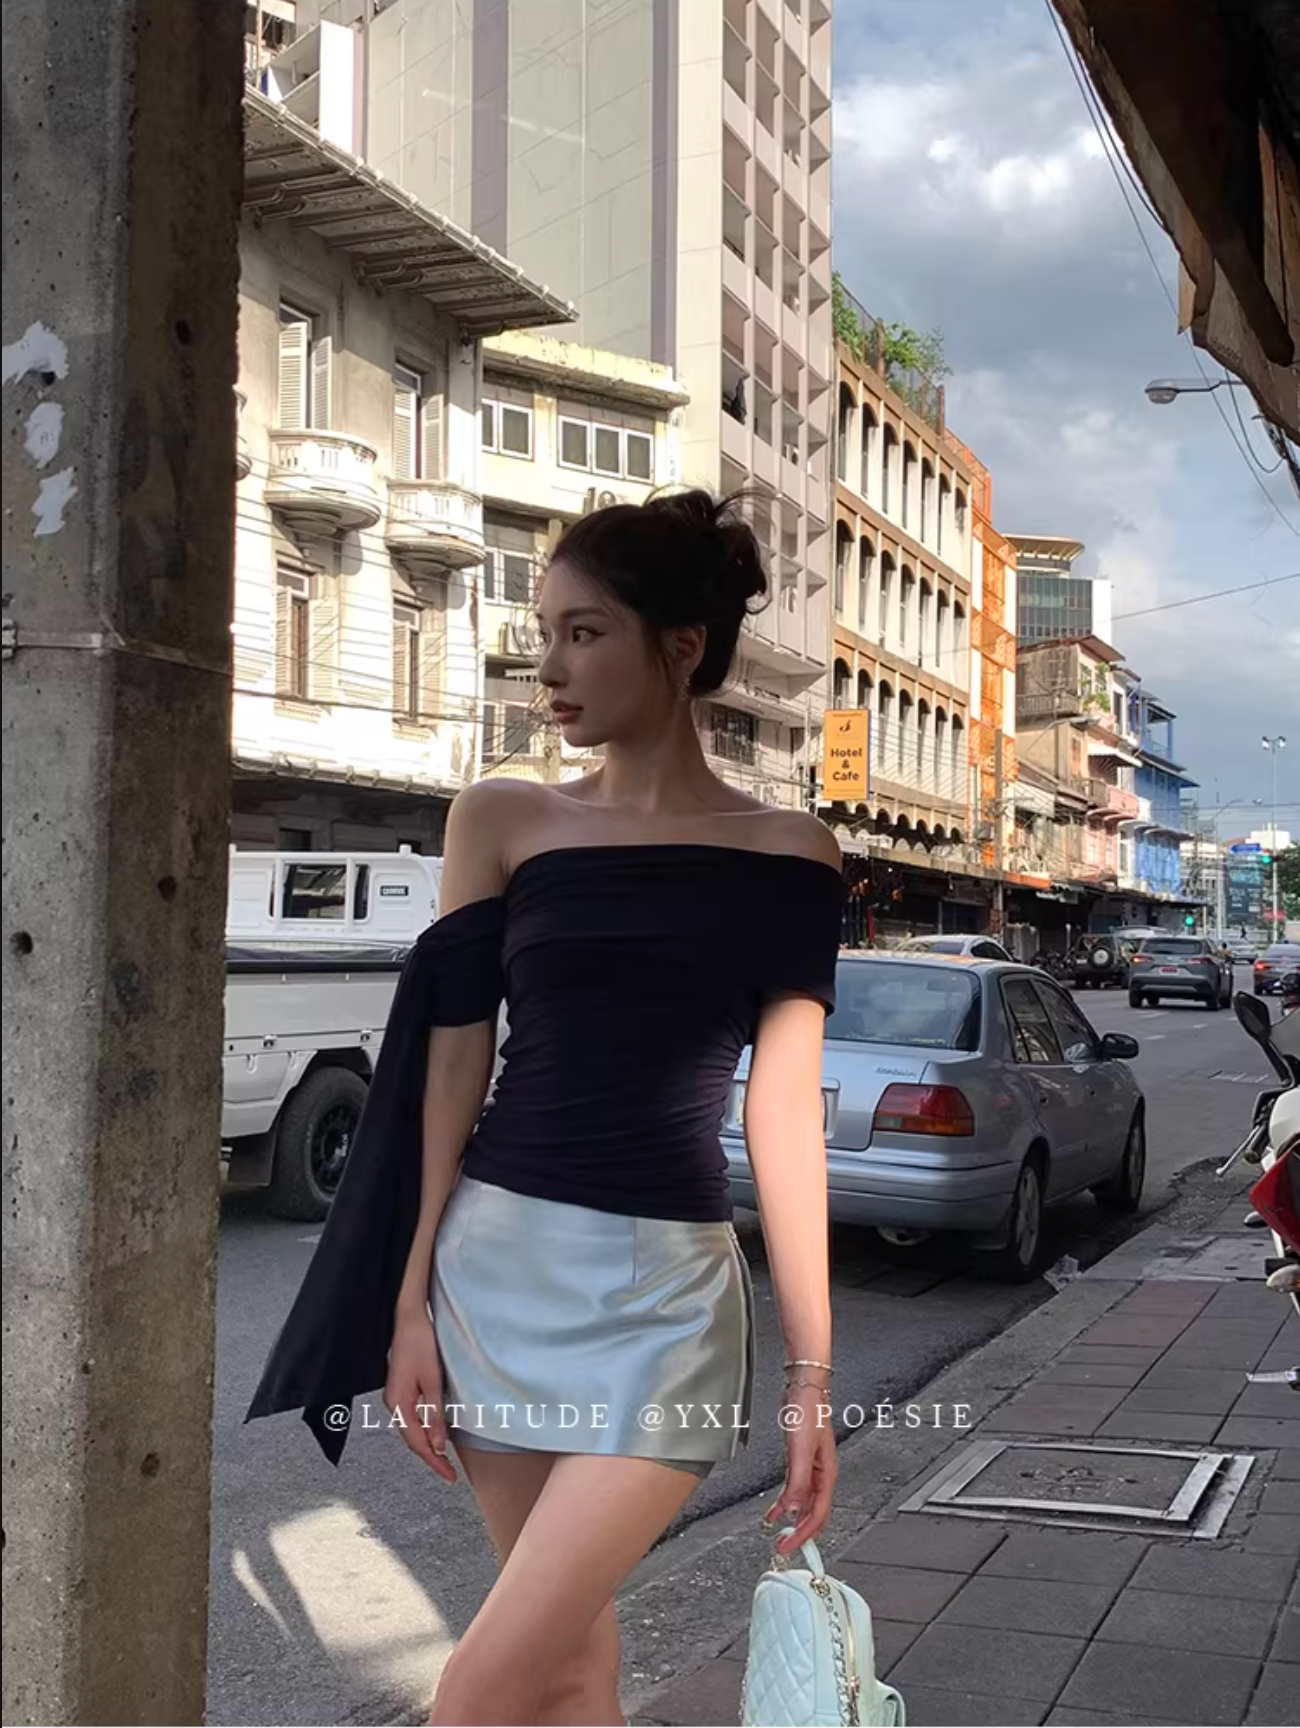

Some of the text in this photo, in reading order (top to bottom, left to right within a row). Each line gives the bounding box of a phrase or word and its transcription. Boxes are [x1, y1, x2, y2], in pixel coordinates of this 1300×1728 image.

[830, 748, 862, 757] Hotel
[842, 759, 850, 769] &
[832, 771, 860, 781] Cafe
